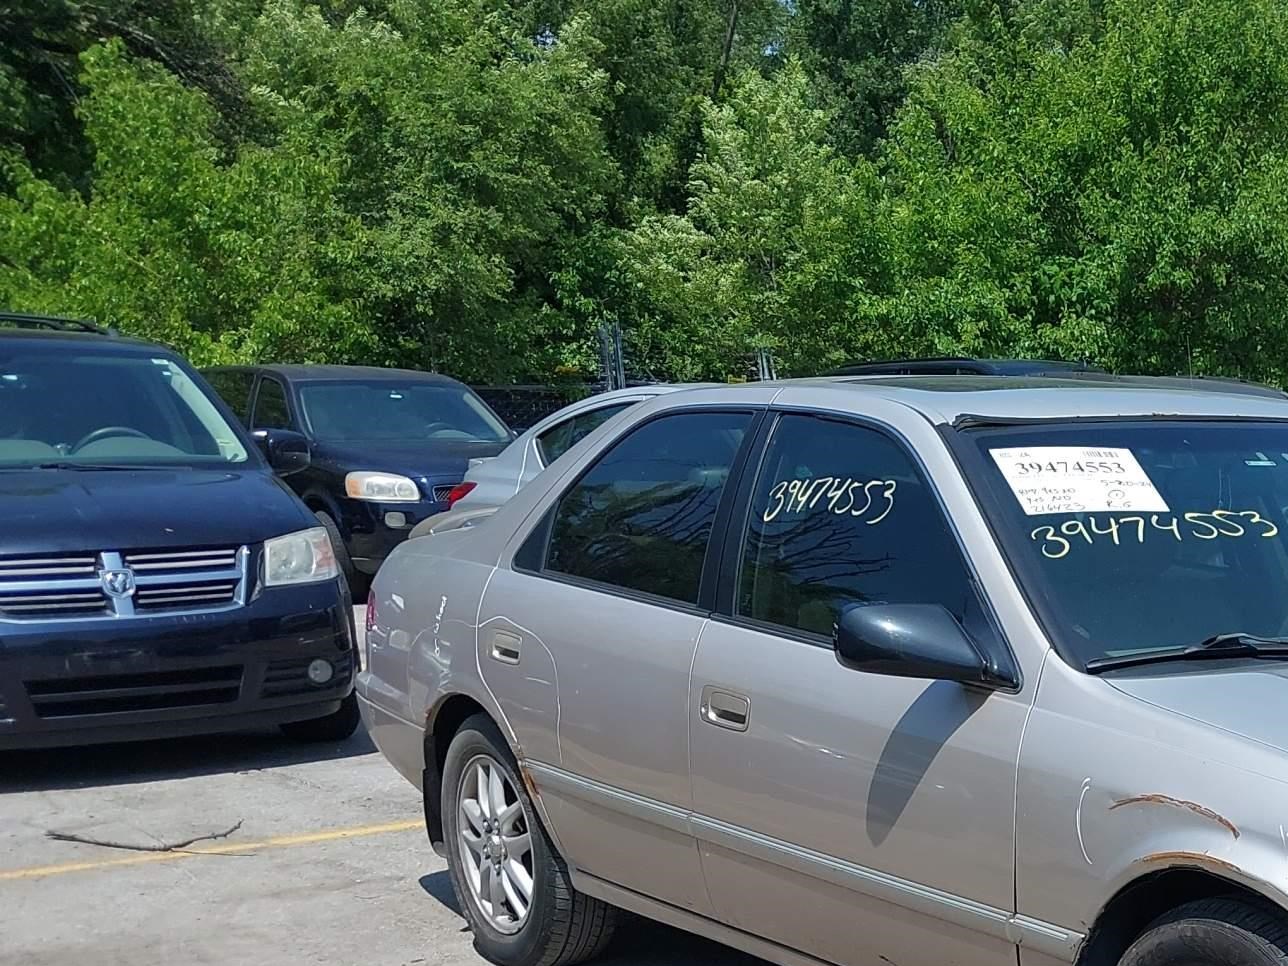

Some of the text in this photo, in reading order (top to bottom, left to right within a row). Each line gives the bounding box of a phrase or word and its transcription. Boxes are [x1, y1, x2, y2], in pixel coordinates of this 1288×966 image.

[1015, 461, 1126, 475] 39474553
[763, 476, 897, 525] 39474553
[1031, 510, 1279, 559] 39474553
